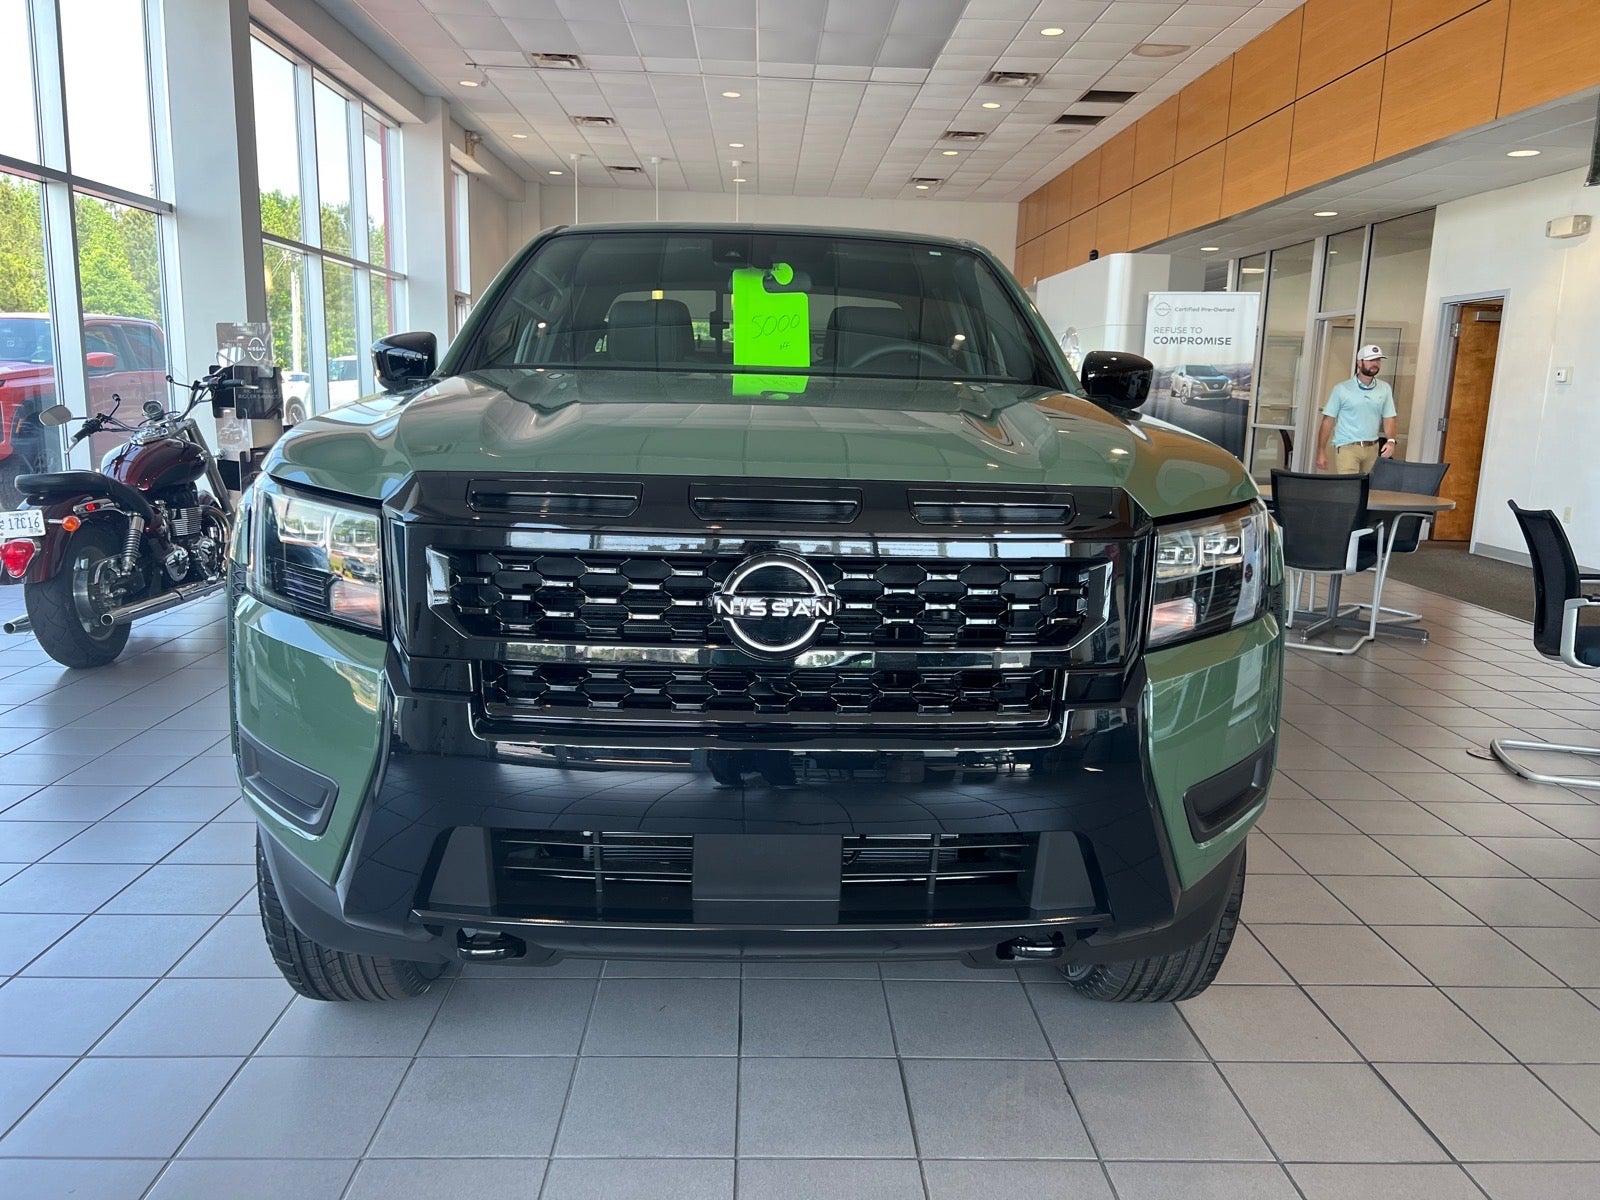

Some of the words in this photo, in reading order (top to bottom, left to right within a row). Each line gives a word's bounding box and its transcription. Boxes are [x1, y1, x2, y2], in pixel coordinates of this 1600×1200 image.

[751, 313, 801, 340] 5000
[1153, 326, 1188, 334] REFUSE
[1190, 326, 1203, 334] TO
[1152, 336, 1233, 346] COMPROMISE
[716, 599, 833, 618] NISSAN
